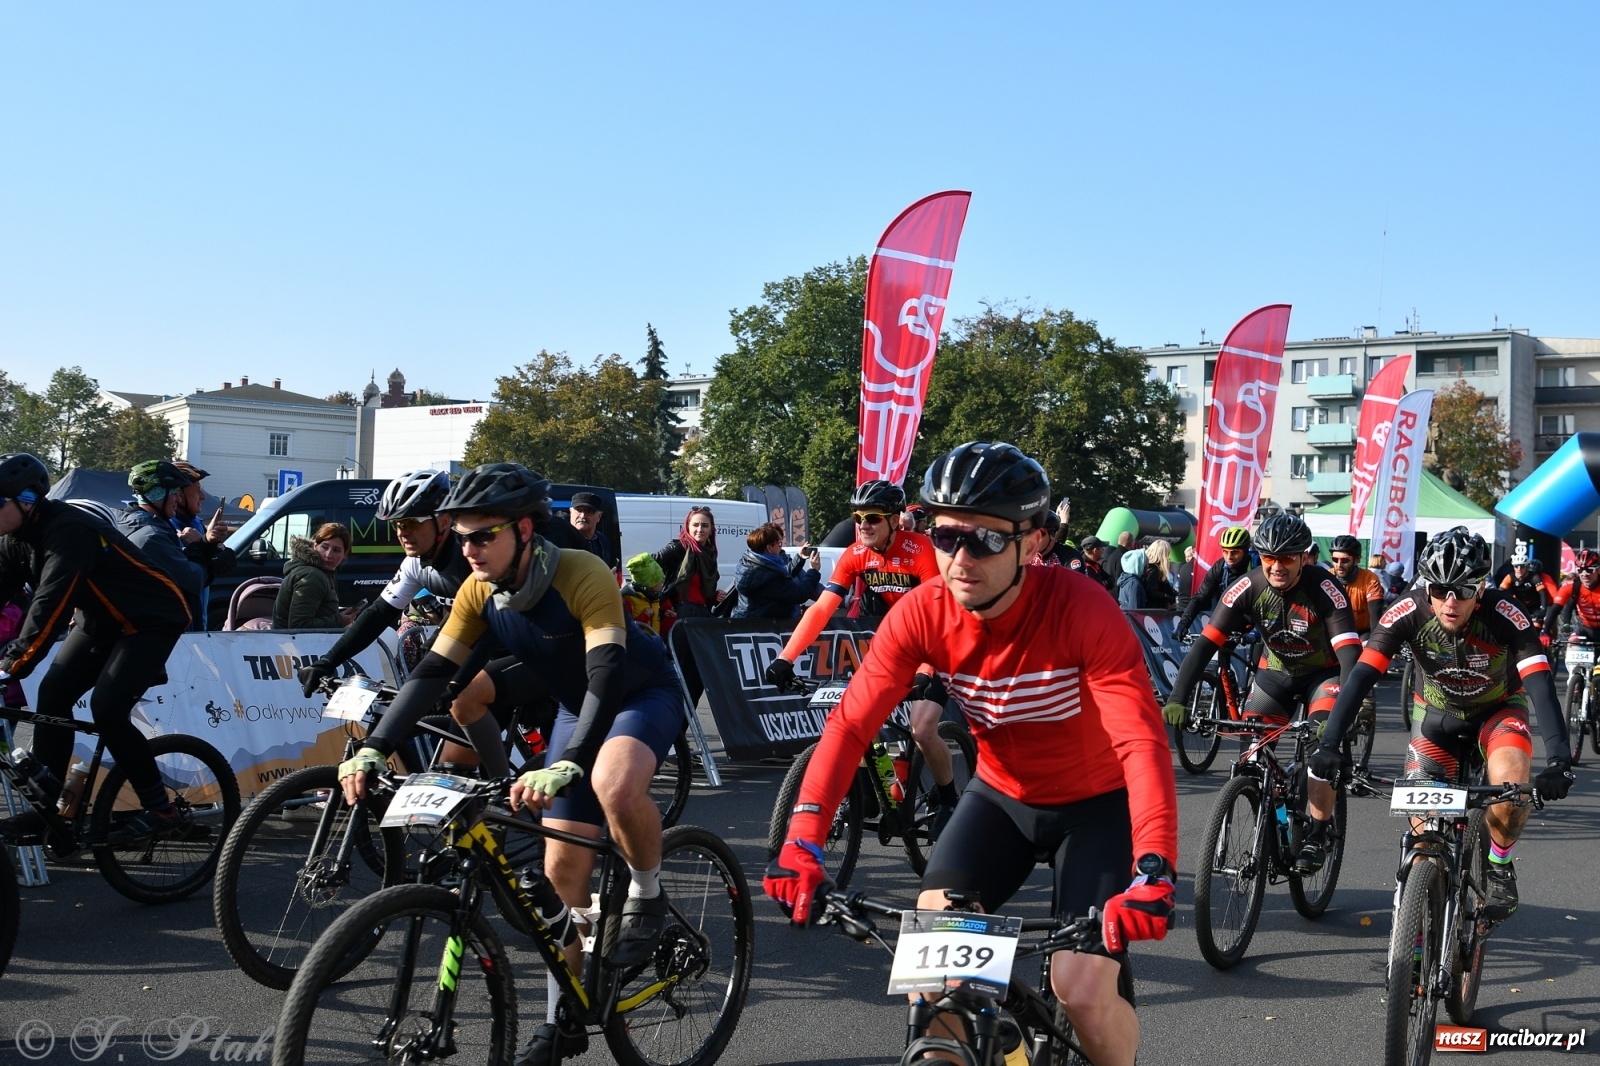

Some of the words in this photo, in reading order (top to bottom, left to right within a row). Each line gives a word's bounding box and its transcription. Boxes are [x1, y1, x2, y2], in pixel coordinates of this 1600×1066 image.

[864, 572, 911, 586] BAHRAIN
[1572, 652, 1590, 660] 1254
[156, 696, 165, 705] E
[819, 690, 842, 700] 106
[401, 792, 448, 809] 1414
[1405, 791, 1454, 805] 1235
[916, 945, 994, 969] 1139
